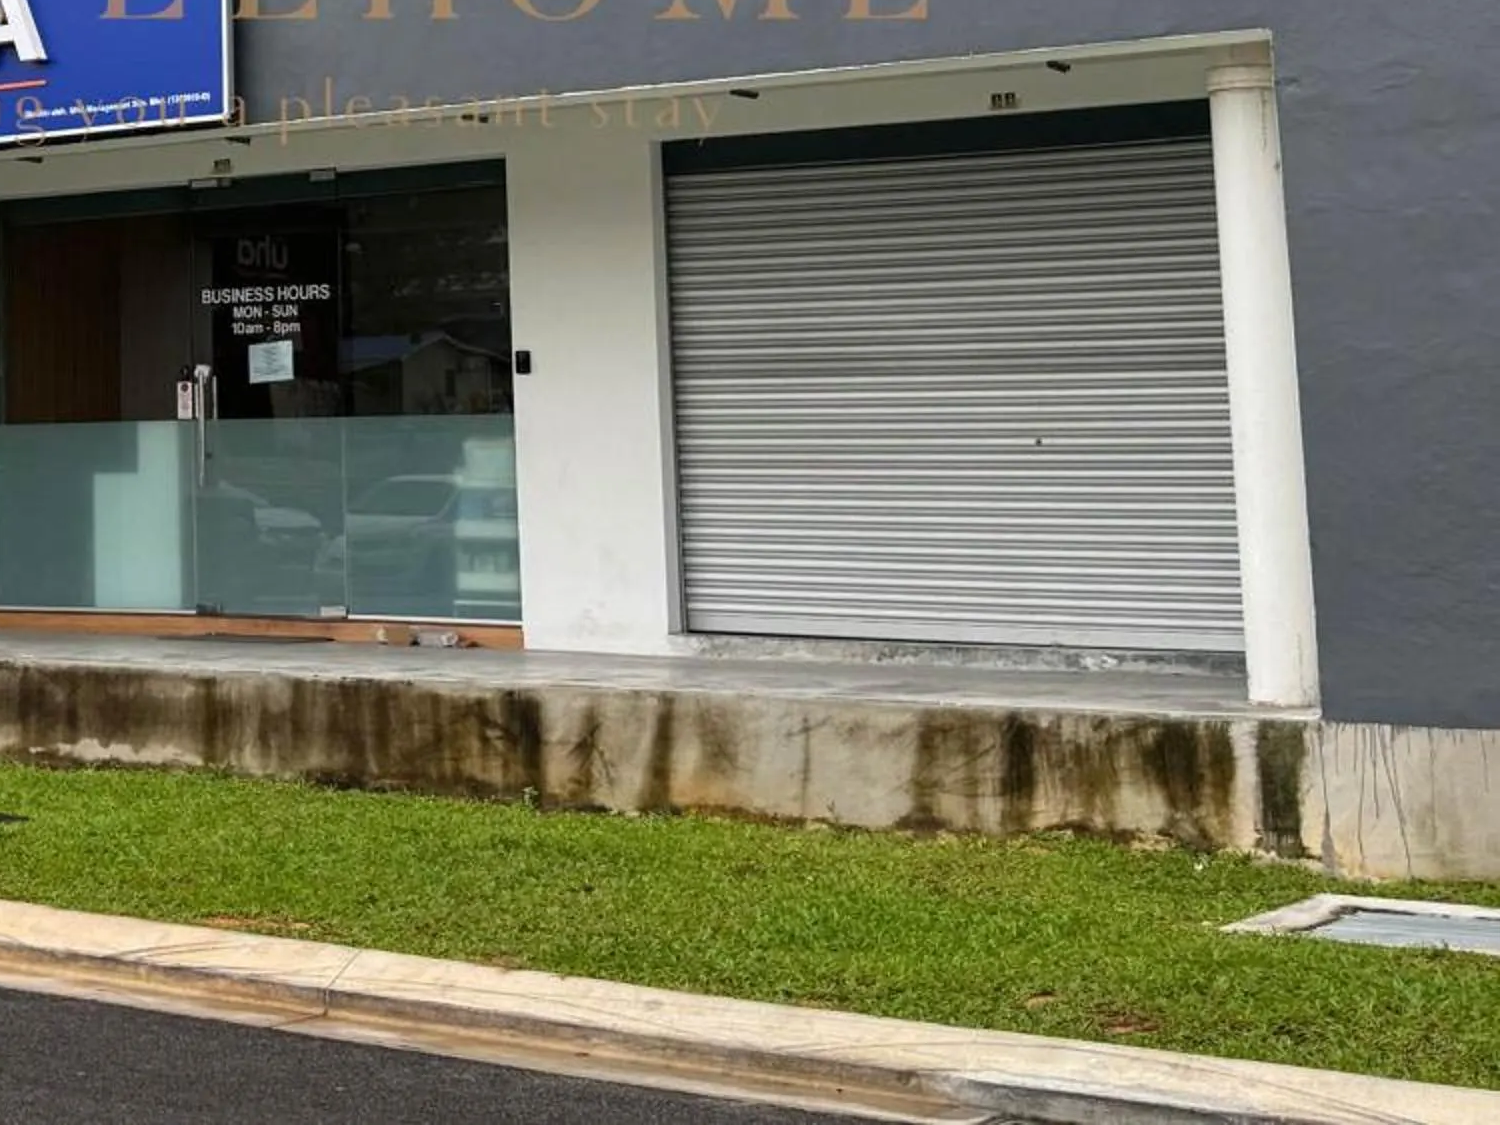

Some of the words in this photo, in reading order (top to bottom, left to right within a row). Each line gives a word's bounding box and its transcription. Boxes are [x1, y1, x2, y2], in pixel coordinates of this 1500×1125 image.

[201, 286, 275, 304] BUSINESS
[277, 283, 331, 300] HOURS
[232, 305, 263, 318] MON
[271, 304, 299, 317] SUN
[231, 321, 264, 335] 10am
[273, 319, 301, 335] 8pm
